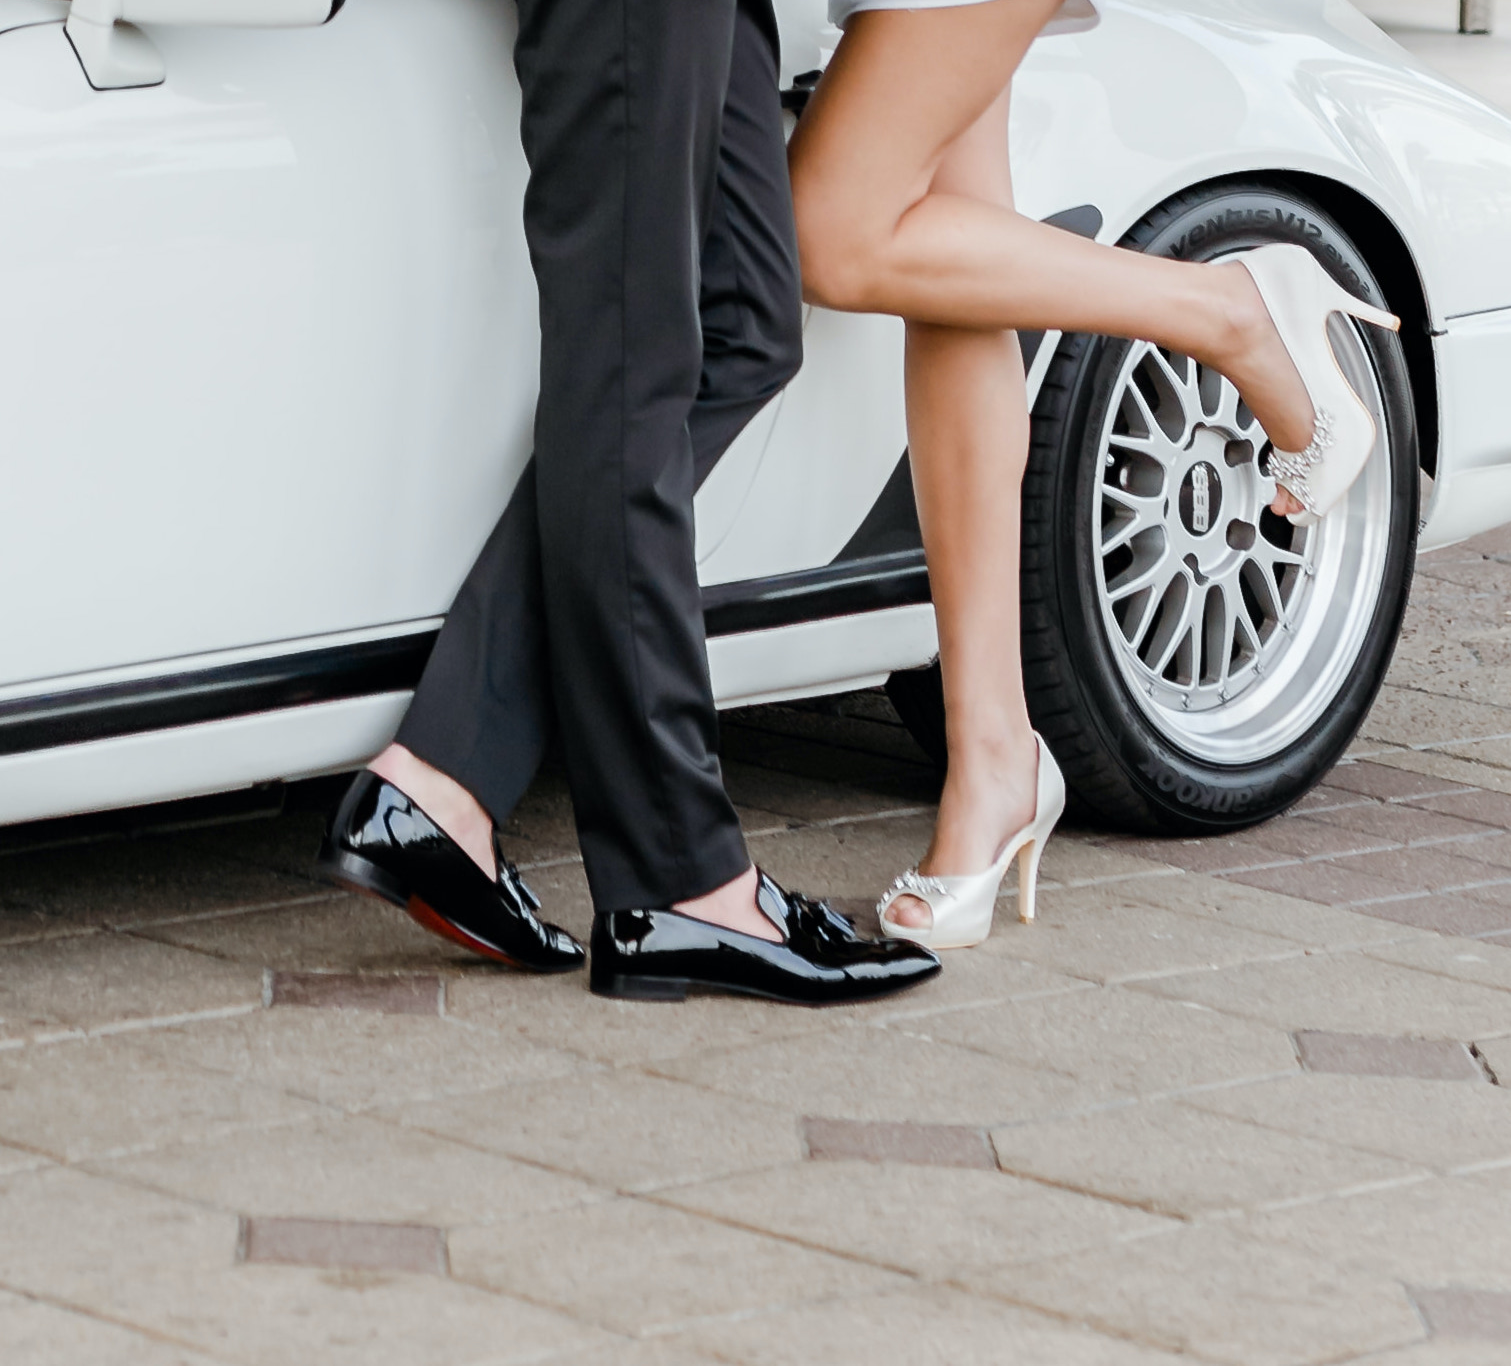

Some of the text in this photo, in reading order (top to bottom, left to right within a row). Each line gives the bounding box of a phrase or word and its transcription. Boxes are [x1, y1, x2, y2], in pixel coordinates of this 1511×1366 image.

[1275, 207, 1323, 240] V12
[1190, 462, 1210, 534] BBS
[1136, 761, 1273, 814] ankook
